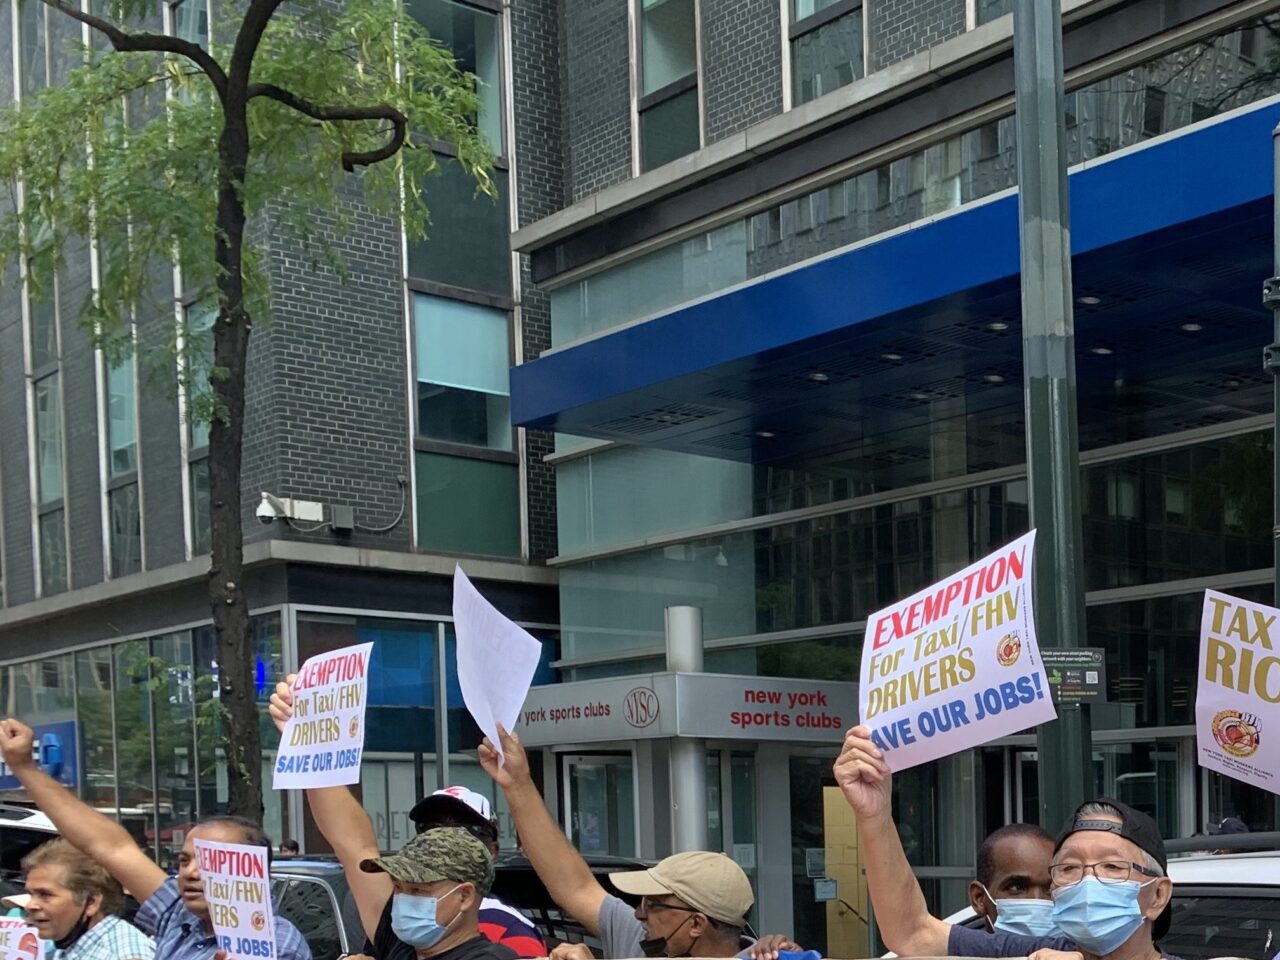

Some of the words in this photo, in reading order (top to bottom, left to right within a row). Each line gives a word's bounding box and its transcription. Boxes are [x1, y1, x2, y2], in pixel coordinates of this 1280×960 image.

[872, 544, 1026, 650] EXEMPTION
[868, 648, 905, 684] For
[913, 585, 1020, 662] Taxi/FHV
[1209, 596, 1276, 650] TAX
[294, 651, 367, 691] EXEMPTION
[866, 646, 976, 720] DRIVERS
[294, 694, 309, 718] For
[312, 683, 363, 715] Taxi/FHV
[525, 708, 546, 726] york
[550, 706, 580, 722] sports
[584, 702, 610, 718] clubs
[744, 689, 784, 704] new
[788, 691, 827, 708] york
[870, 718, 916, 752] AVE
[918, 703, 969, 738] OUR
[975, 672, 1044, 720] JOBS!
[289, 716, 340, 746] DRIVERS
[730, 711, 790, 728] sports
[796, 712, 842, 730] clubs
[276, 755, 310, 773] SAVE
[312, 752, 332, 772] OUR
[334, 747, 360, 769] JOBS!
[208, 876, 263, 905] Taxi/FHV
[216, 935, 232, 953] UR
[236, 937, 274, 958] JOBS!
